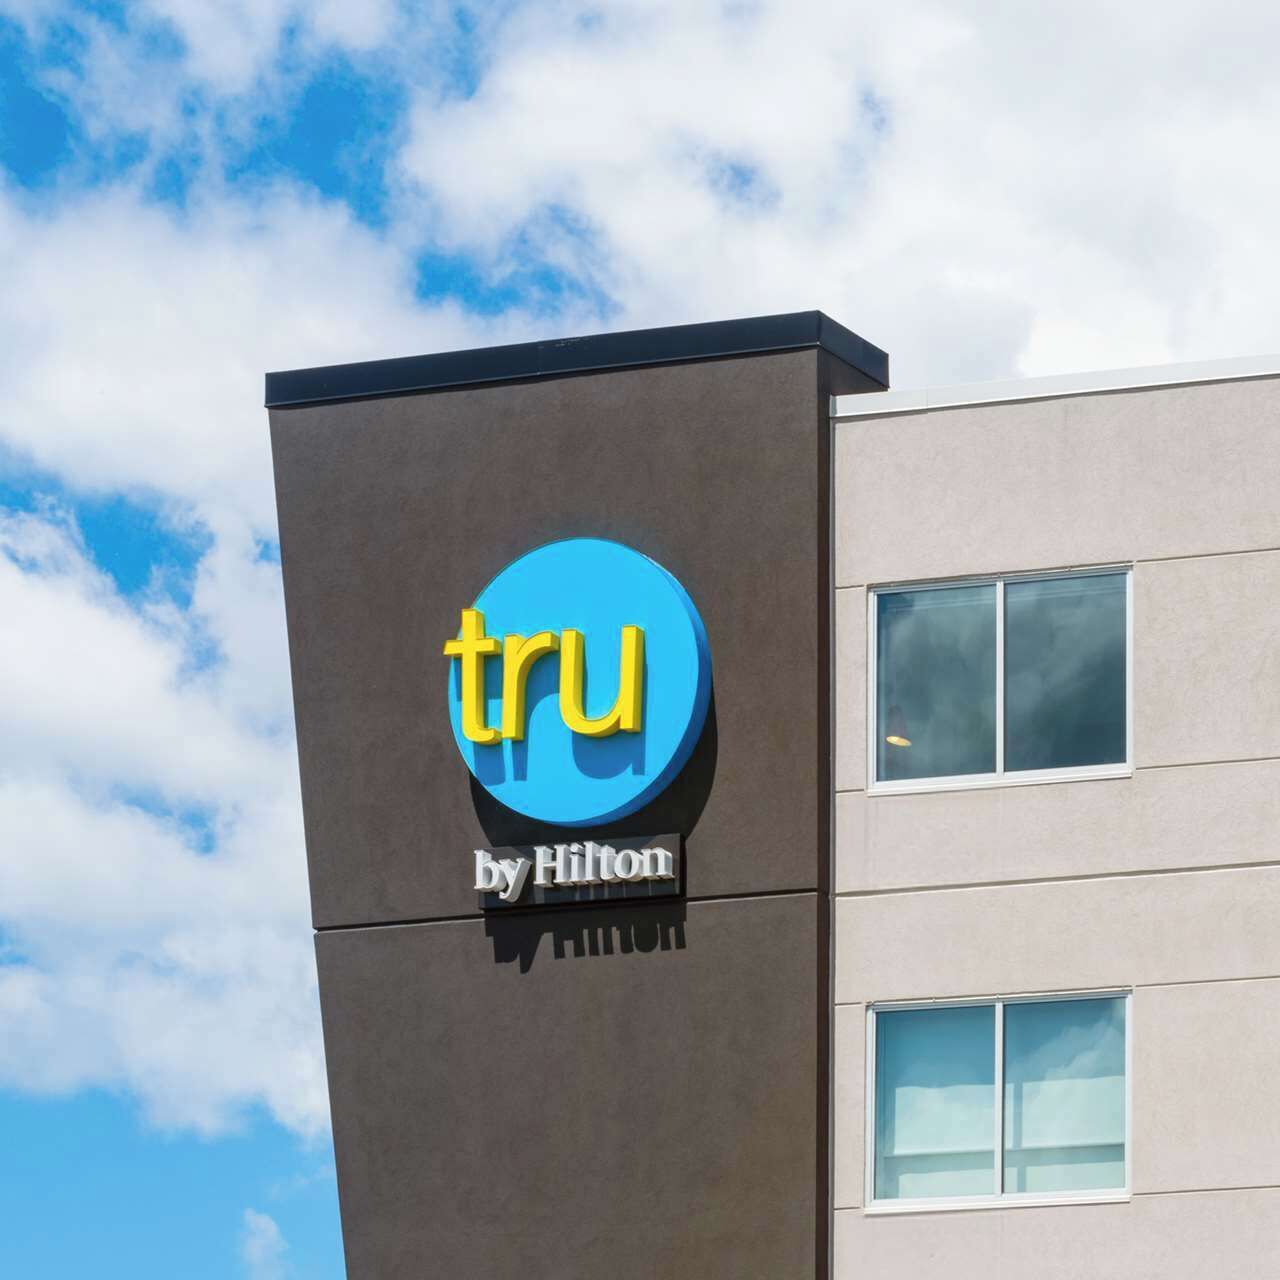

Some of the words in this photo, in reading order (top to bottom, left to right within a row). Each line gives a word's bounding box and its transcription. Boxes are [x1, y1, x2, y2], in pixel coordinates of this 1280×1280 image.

[443, 608, 645, 745] tru
[474, 849, 531, 902] by
[534, 841, 675, 888] Hilton
